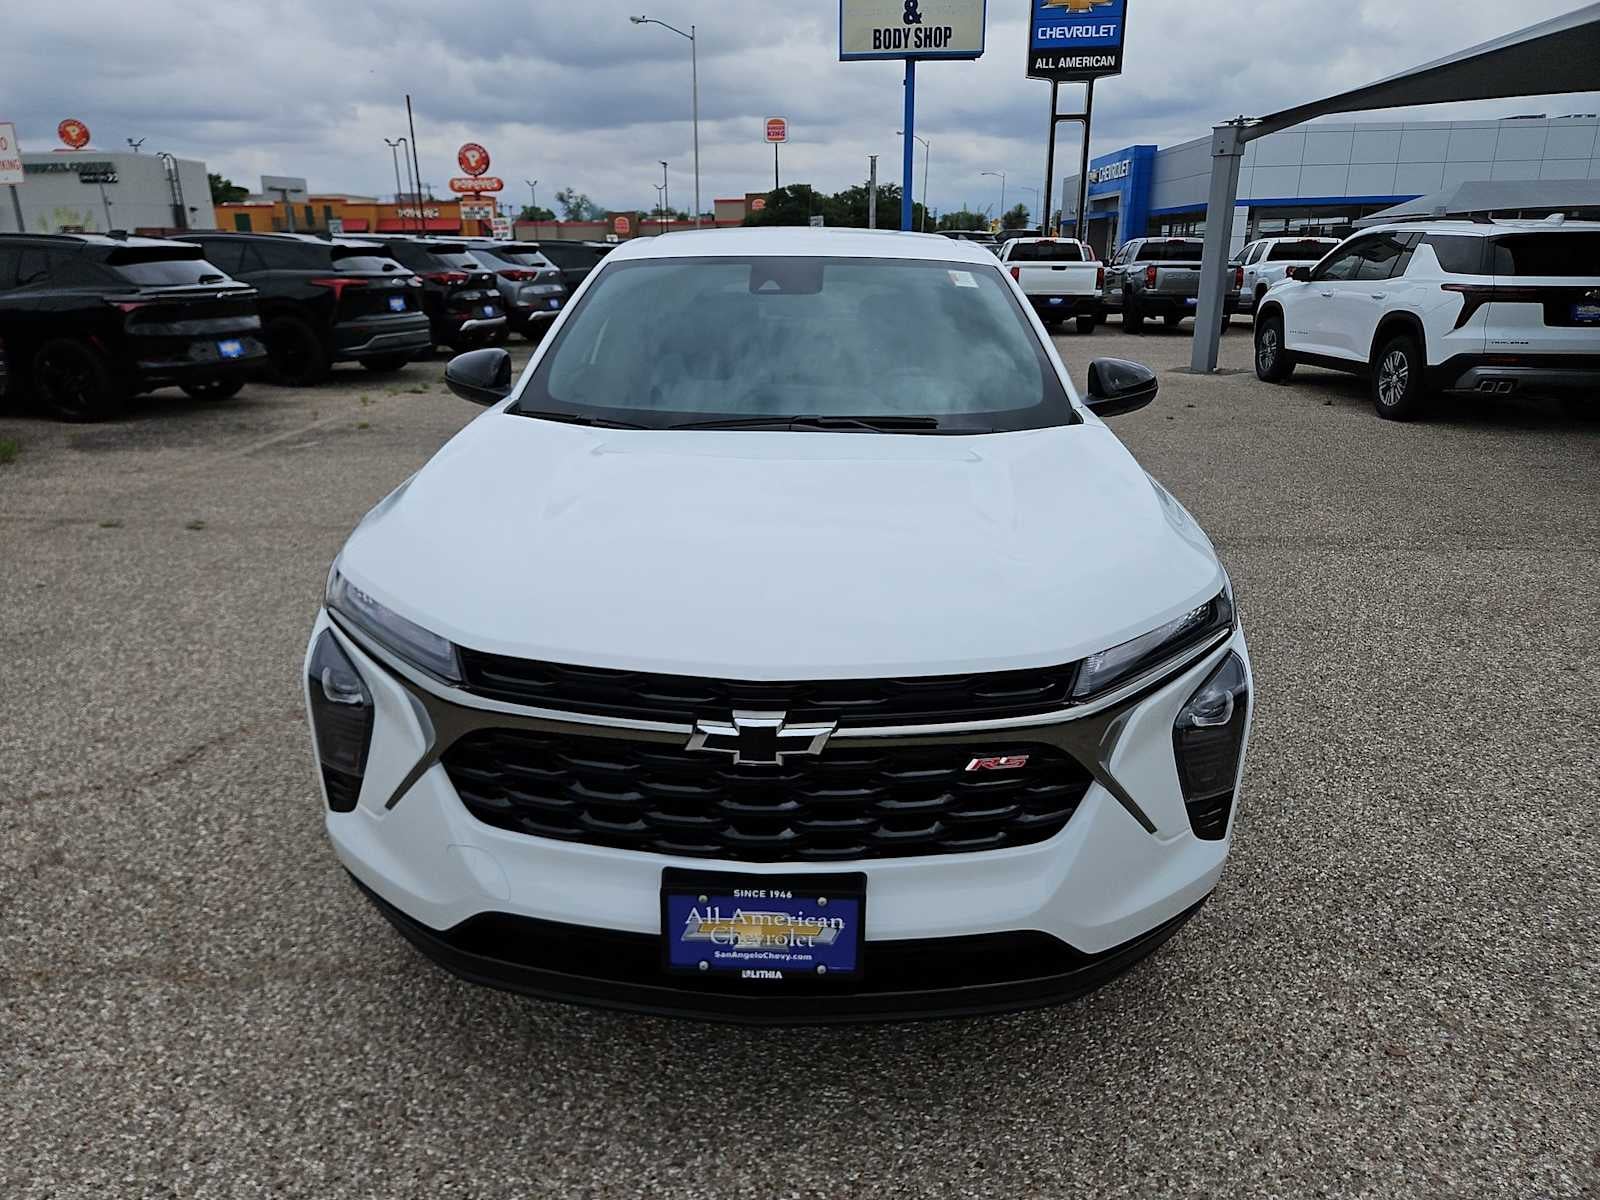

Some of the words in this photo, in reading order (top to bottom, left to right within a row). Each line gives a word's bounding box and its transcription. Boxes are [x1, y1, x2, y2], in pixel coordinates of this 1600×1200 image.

[903, 0, 922, 24] &
[873, 27, 913, 50] BODY
[914, 26, 953, 49] SHOP
[1037, 24, 1117, 40] CHEVROLET
[1035, 57, 1055, 69] ALL
[1058, 55, 1116, 69] AMERICAN
[1099, 160, 1130, 182] CHEVROLET
[965, 754, 1030, 771] RS
[733, 889, 766, 899] SINCE
[769, 889, 793, 899] 1946
[685, 906, 721, 925] All
[729, 908, 844, 928] American
[711, 926, 815, 947] Chevrolet
[714, 951, 813, 961] SanAngeloChevy.com
[750, 969, 783, 979] LITHIA
